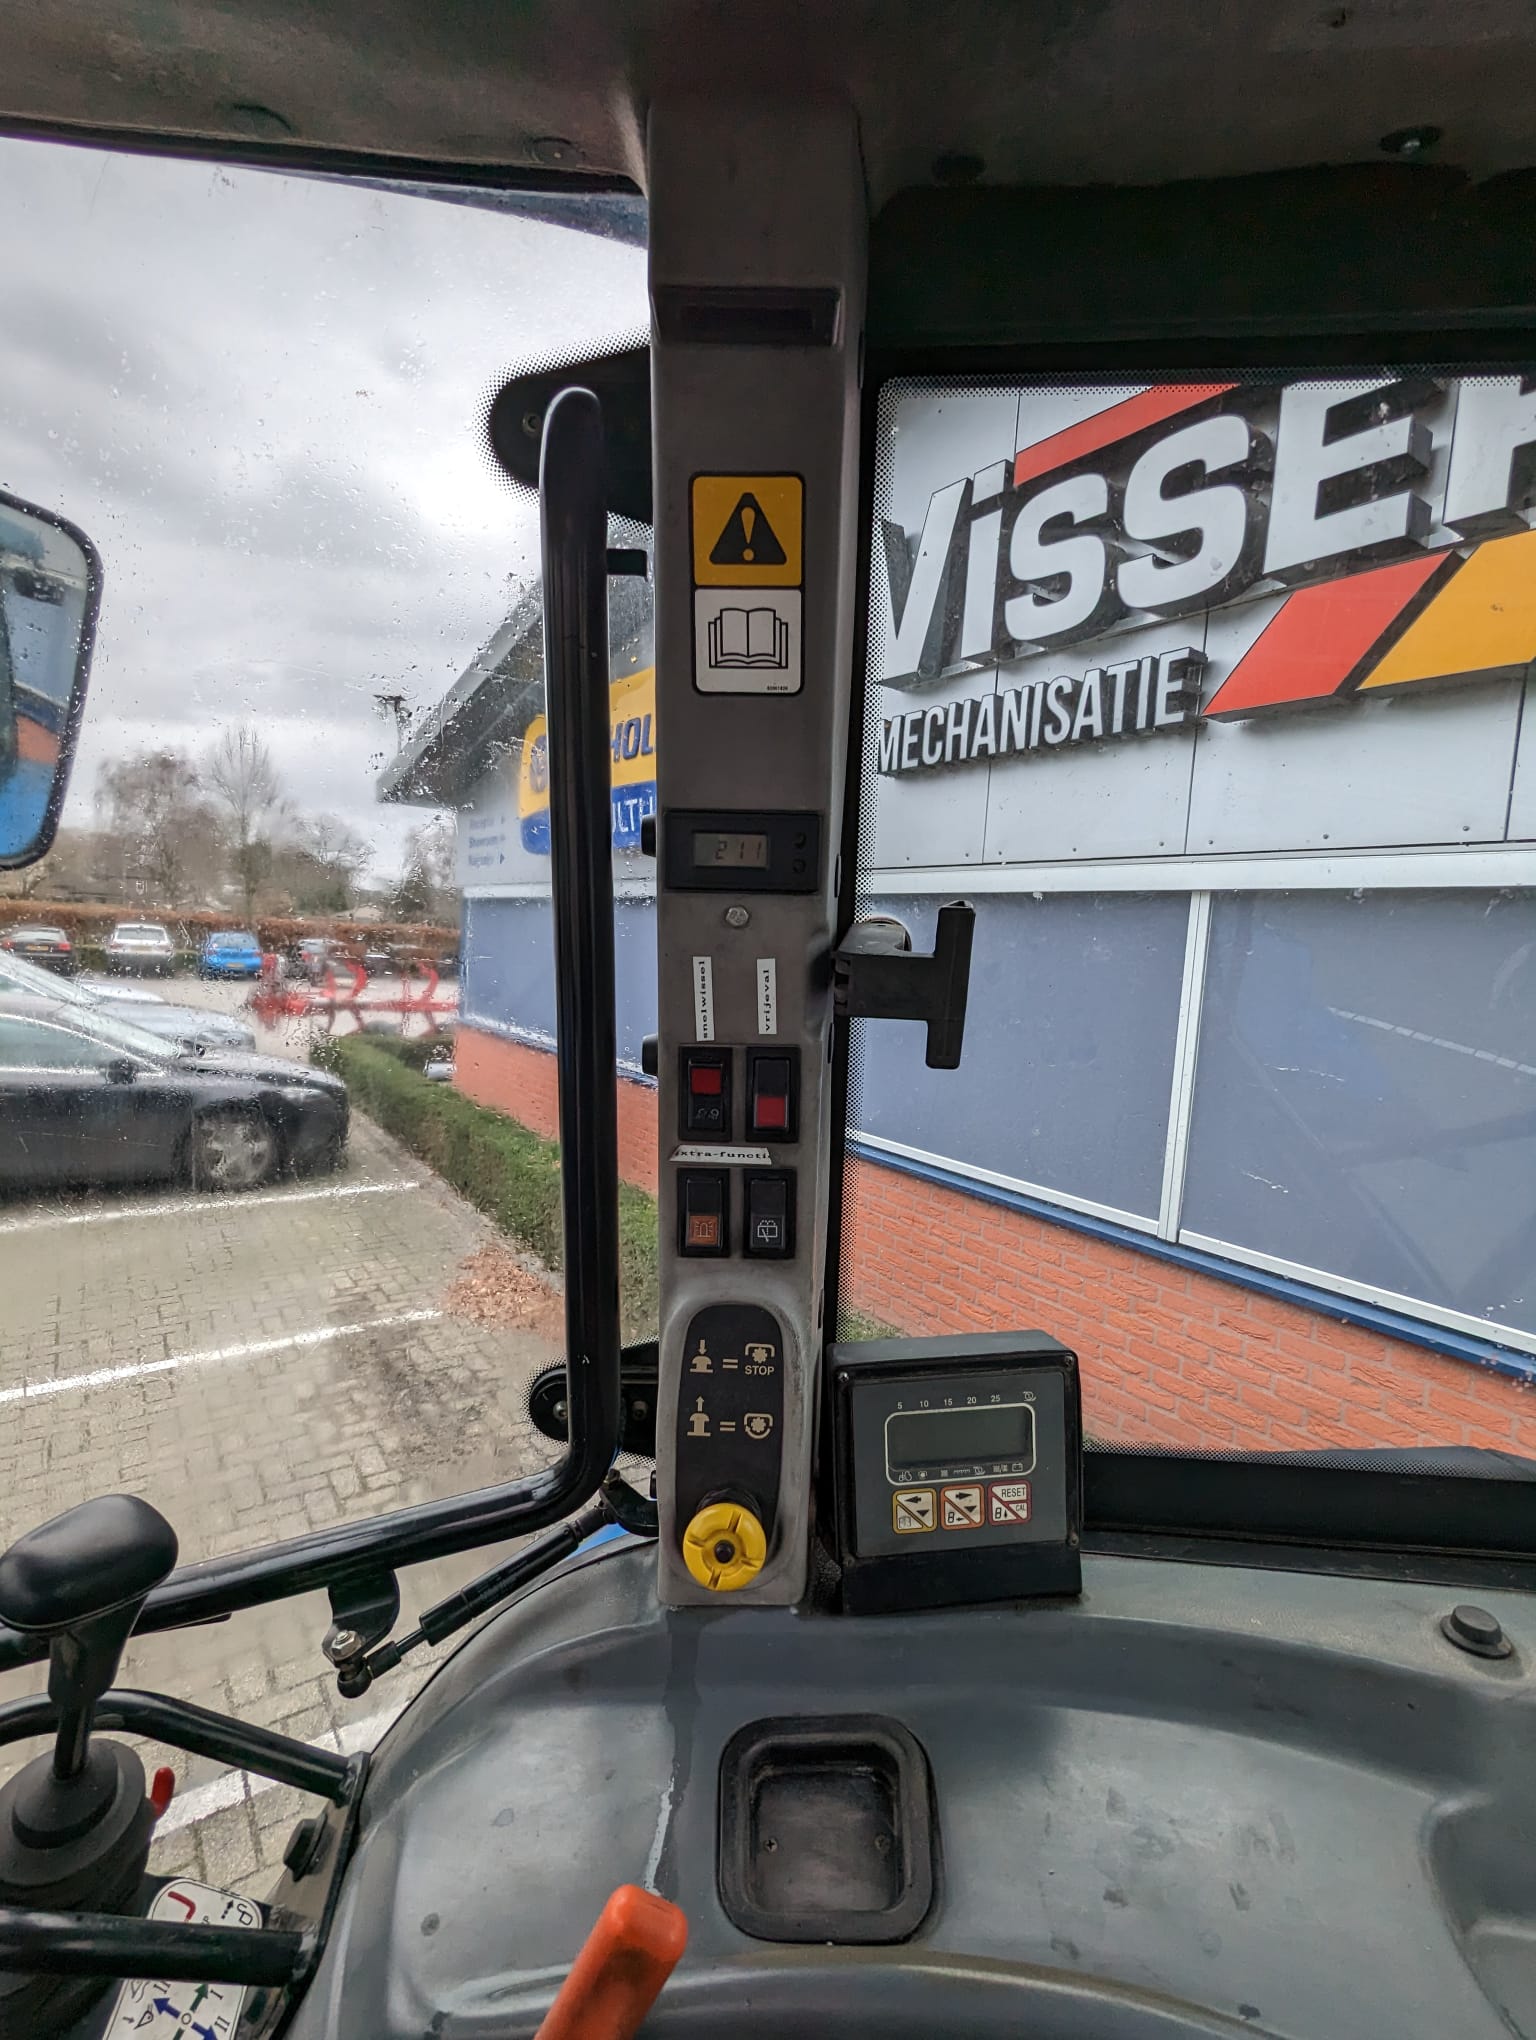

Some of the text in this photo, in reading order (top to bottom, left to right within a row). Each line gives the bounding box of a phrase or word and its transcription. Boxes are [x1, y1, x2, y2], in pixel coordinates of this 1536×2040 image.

[878, 646, 1192, 775] MECHANISATIE
[698, 961, 708, 1038] snelwissel
[762, 969, 772, 1032] vrijeval
[744, 1365, 775, 1376] STOP
[897, 1394, 1001, 1409] 5 10 15 20 25
[1001, 1487, 1026, 1498] RESET
[1015, 1504, 1026, 1512] CAL
